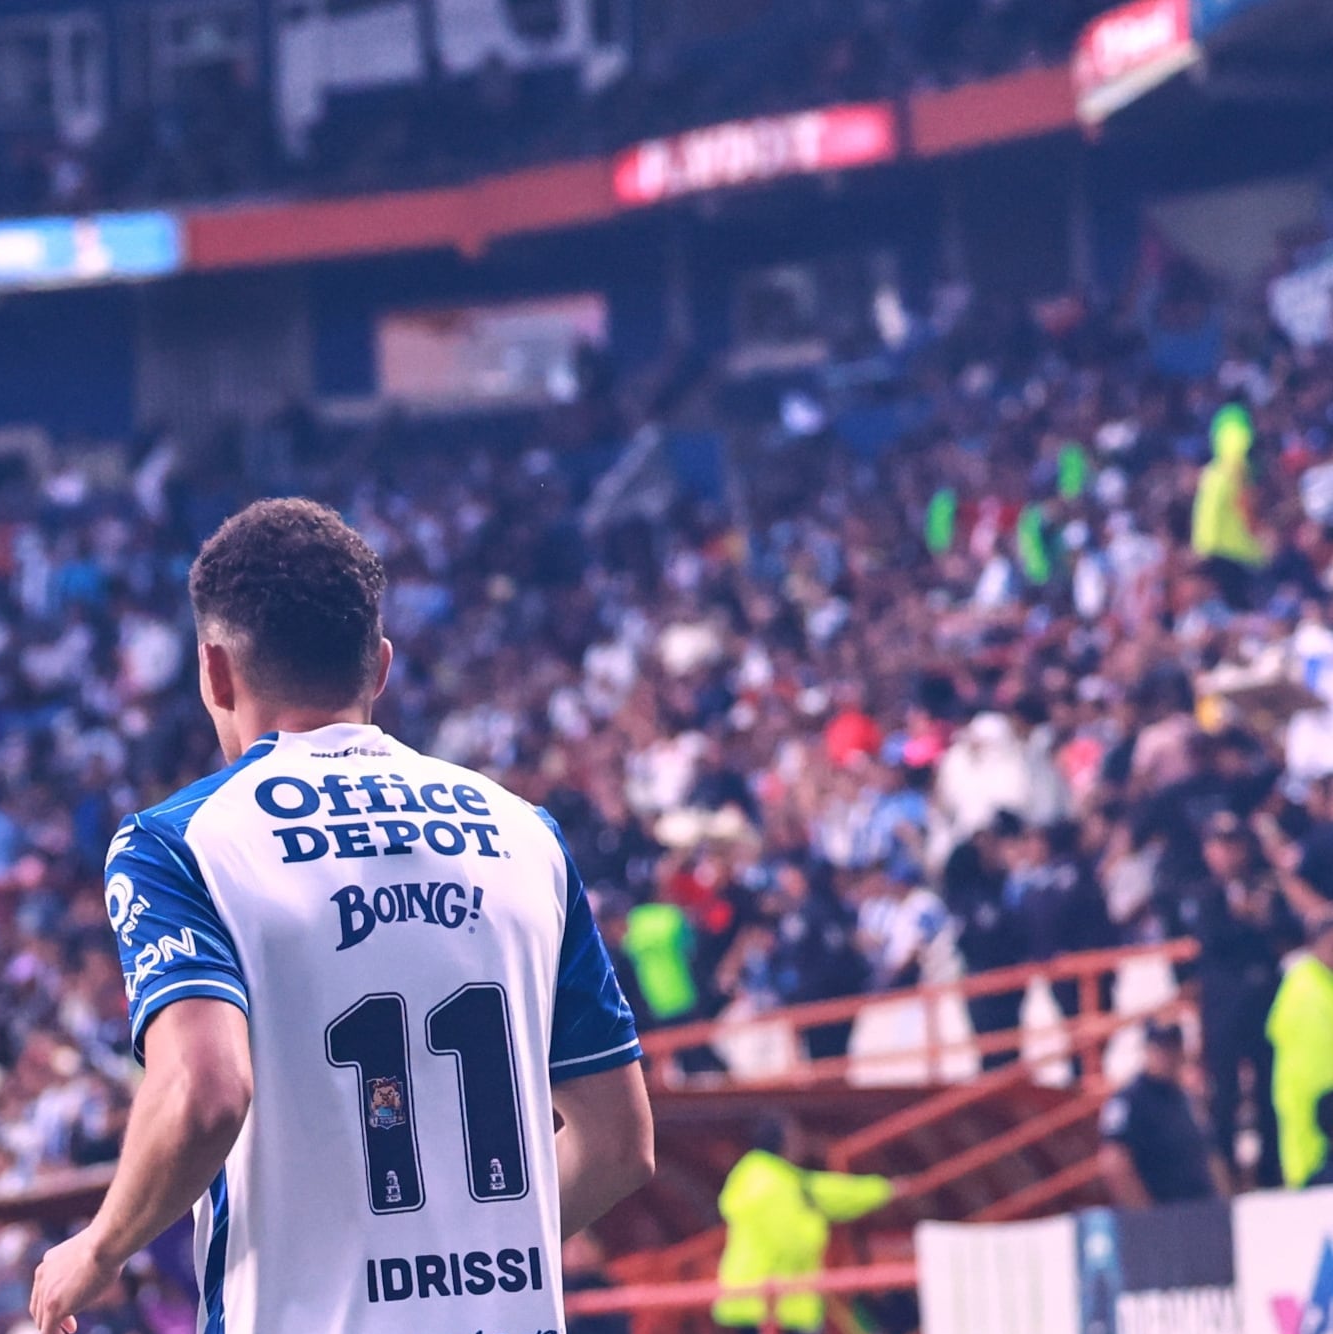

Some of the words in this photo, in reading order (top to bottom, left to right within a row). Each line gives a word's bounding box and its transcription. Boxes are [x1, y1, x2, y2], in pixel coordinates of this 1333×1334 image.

[254, 774, 492, 819] Office
[271, 820, 501, 863] DEPOT
[324, 981, 530, 1216] 11
[366, 1247, 543, 1303] IDRISSI
